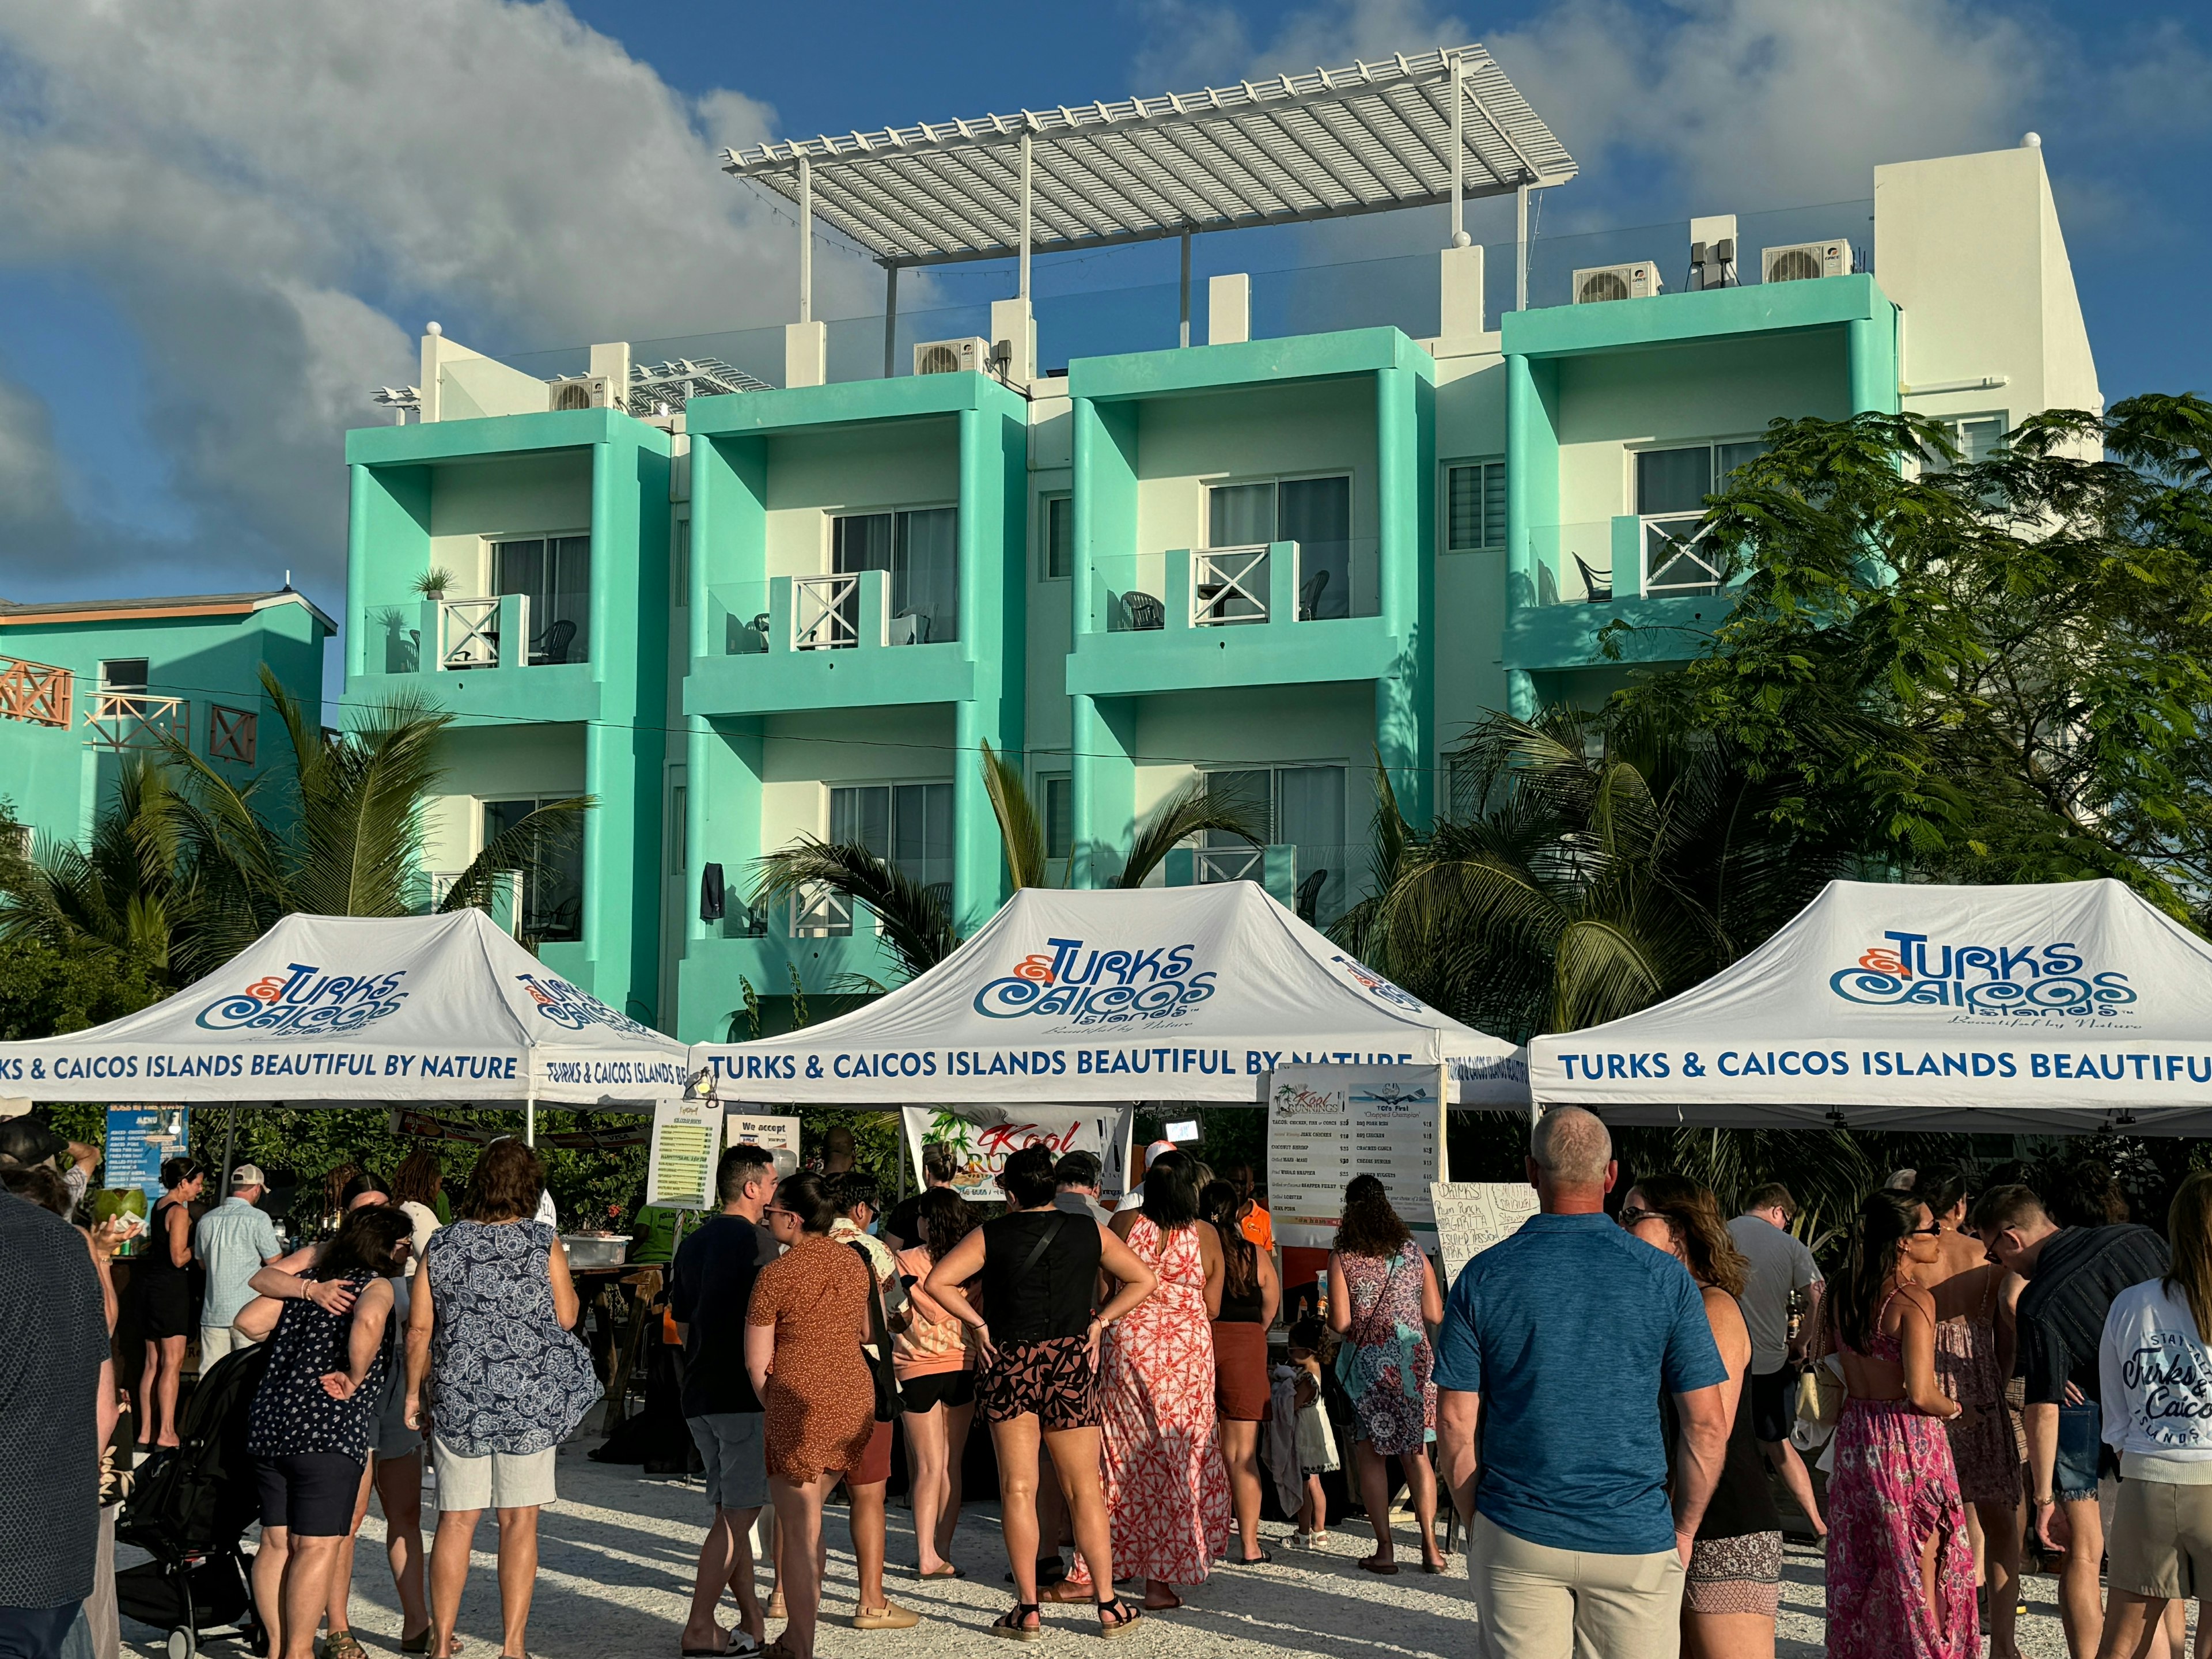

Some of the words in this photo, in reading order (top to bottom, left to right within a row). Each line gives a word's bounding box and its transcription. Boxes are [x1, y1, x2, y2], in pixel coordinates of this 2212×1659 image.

[1043, 938, 1195, 988] TURKS
[1884, 931, 2083, 982] TURKS
[267, 963, 407, 1006] TURKS
[974, 972, 1217, 1019] CAICOS
[1830, 968, 2138, 1008] CAICOS
[31, 1058, 46, 1079] &
[54, 1055, 138, 1079] CAICOS
[146, 1054, 243, 1077] ISLANDS
[251, 1054, 376, 1075] BEAUTIFUL
[385, 1055, 416, 1075] BY
[421, 1055, 517, 1080] NATURE
[547, 1062, 582, 1084] TURKS
[584, 1062, 592, 1084] &
[594, 1062, 632, 1084] CAICOS
[634, 1062, 675, 1085] ISLANDS
[708, 1055, 796, 1080] TURKS
[805, 1055, 823, 1079] &
[834, 1052, 937, 1079] CAICOS
[948, 1050, 1066, 1076] ISLANDS
[1078, 1048, 1236, 1075] BEAUTIFUL
[1247, 1051, 1282, 1075] BY
[1558, 1052, 1671, 1081] TURKS
[1682, 1052, 1706, 1078] &
[1718, 1051, 1850, 1077] CAICOS
[1863, 1051, 2017, 1078] ISLANDS
[1289, 1104, 1338, 1113] RUNNINGS
[1293, 1091, 1332, 1107] Kool
[743, 1122, 755, 1131] We
[758, 1124, 786, 1134] accept
[977, 1120, 1081, 1157] Kool
[2150, 1332, 2184, 1346] STAY
[2123, 1347, 2196, 1390] Turks
[2191, 1378, 2207, 1398] &
